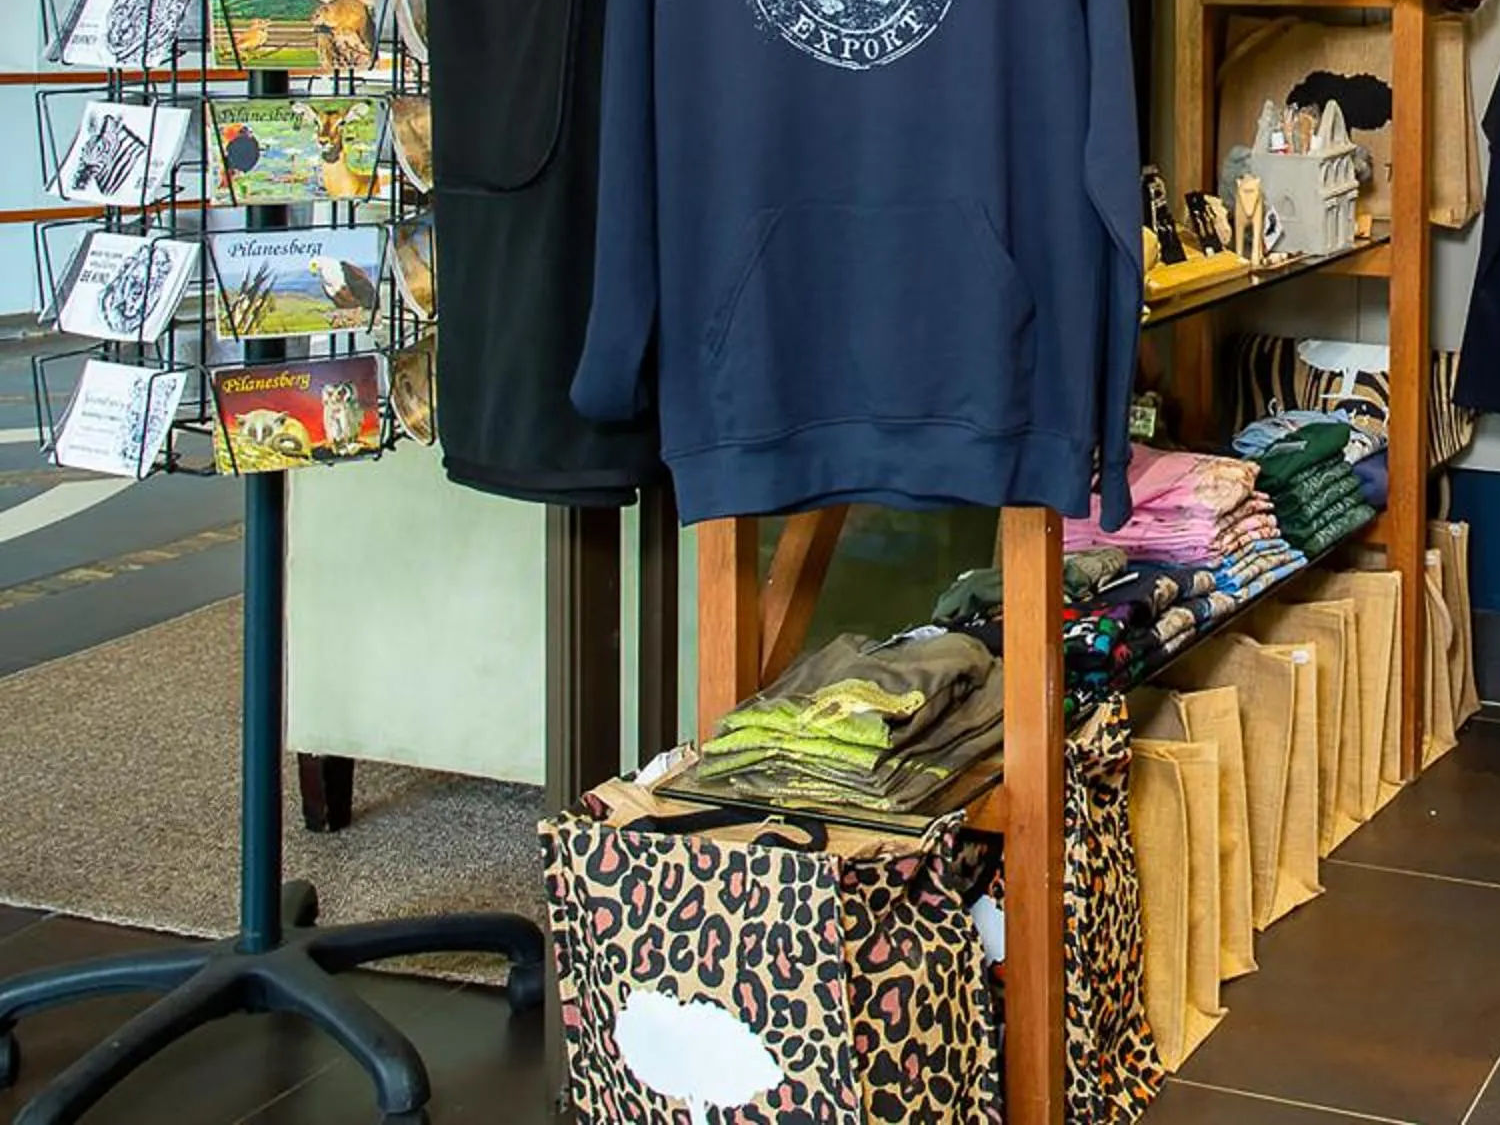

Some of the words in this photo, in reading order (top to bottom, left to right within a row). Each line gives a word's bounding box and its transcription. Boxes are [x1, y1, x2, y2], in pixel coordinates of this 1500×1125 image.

[790, 9, 923, 60] EXPORT
[227, 238, 323, 257] Pilanesberg
[222, 370, 311, 394] Pilanesberg
